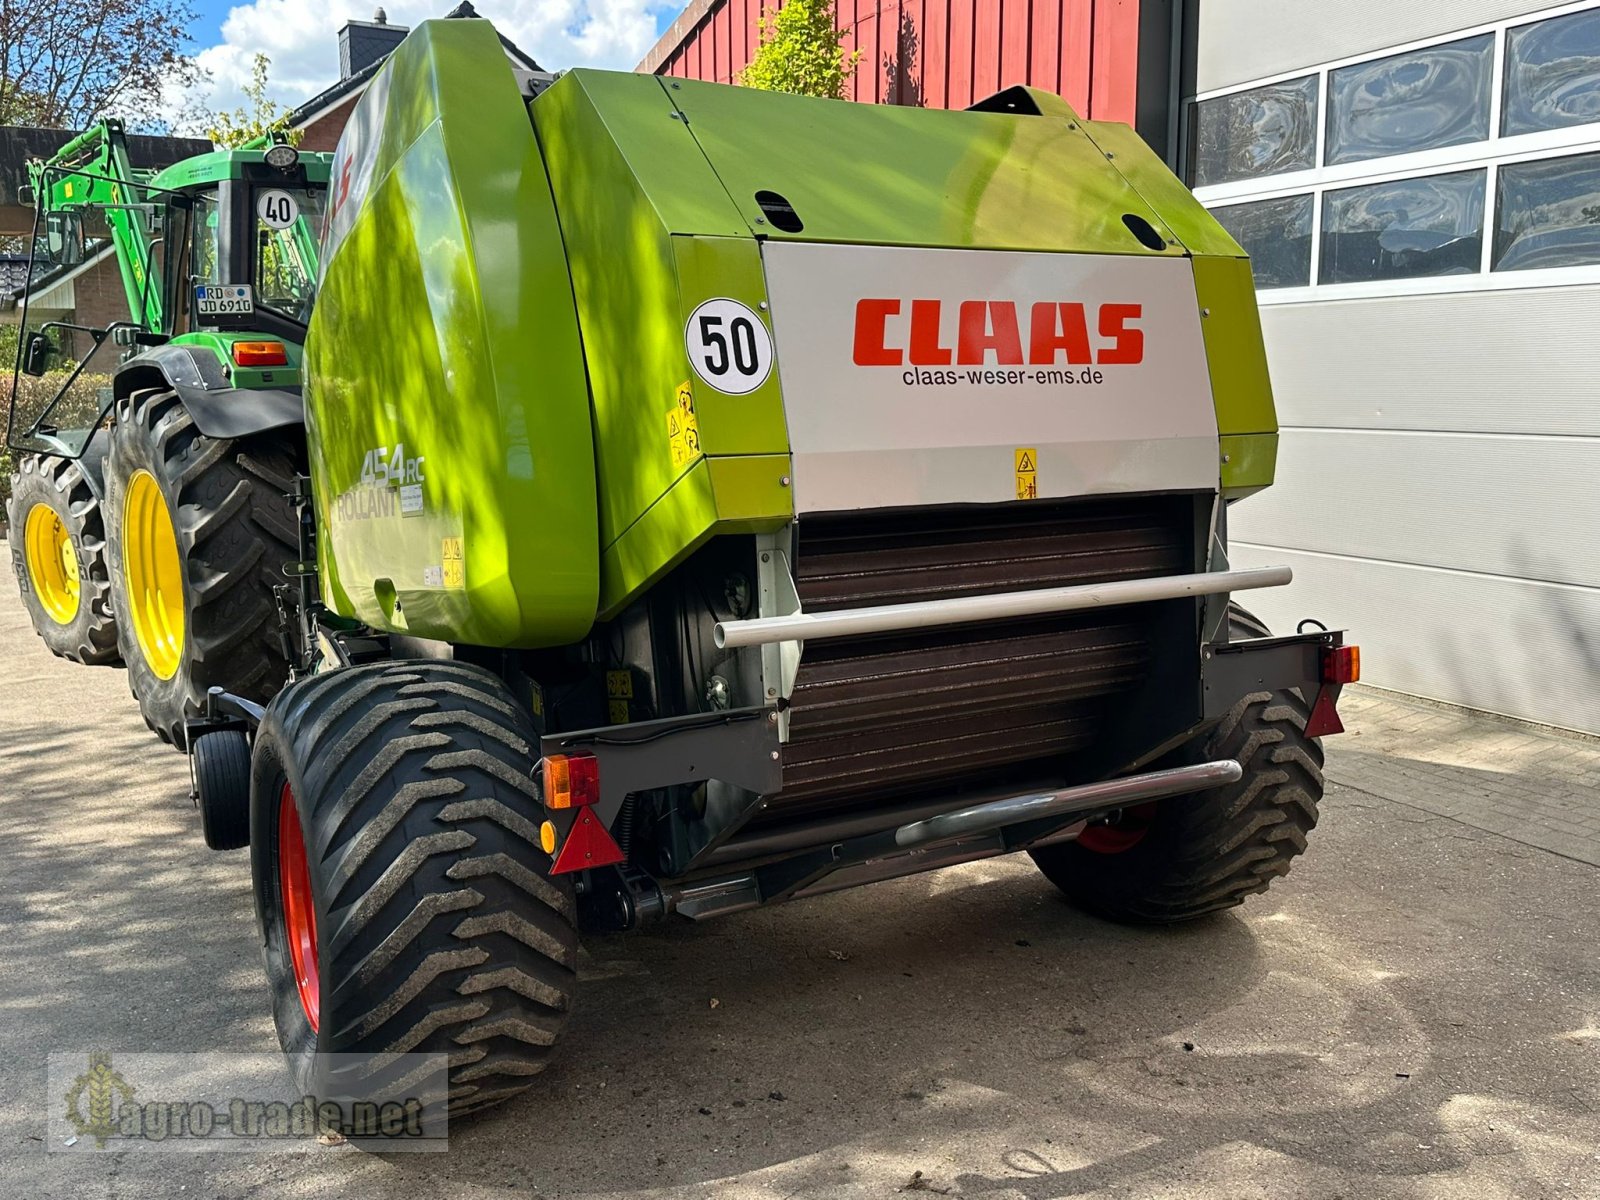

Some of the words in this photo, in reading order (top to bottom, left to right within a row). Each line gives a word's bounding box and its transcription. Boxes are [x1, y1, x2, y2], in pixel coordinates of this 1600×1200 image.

[266, 196, 291, 222] 40
[200, 300, 217, 312] JD
[206, 287, 223, 300] RD
[852, 298, 1144, 366] CLAAS
[699, 315, 759, 376] 50
[902, 367, 1104, 386] claas-weser-ems.de
[337, 486, 397, 522] ROLLANT
